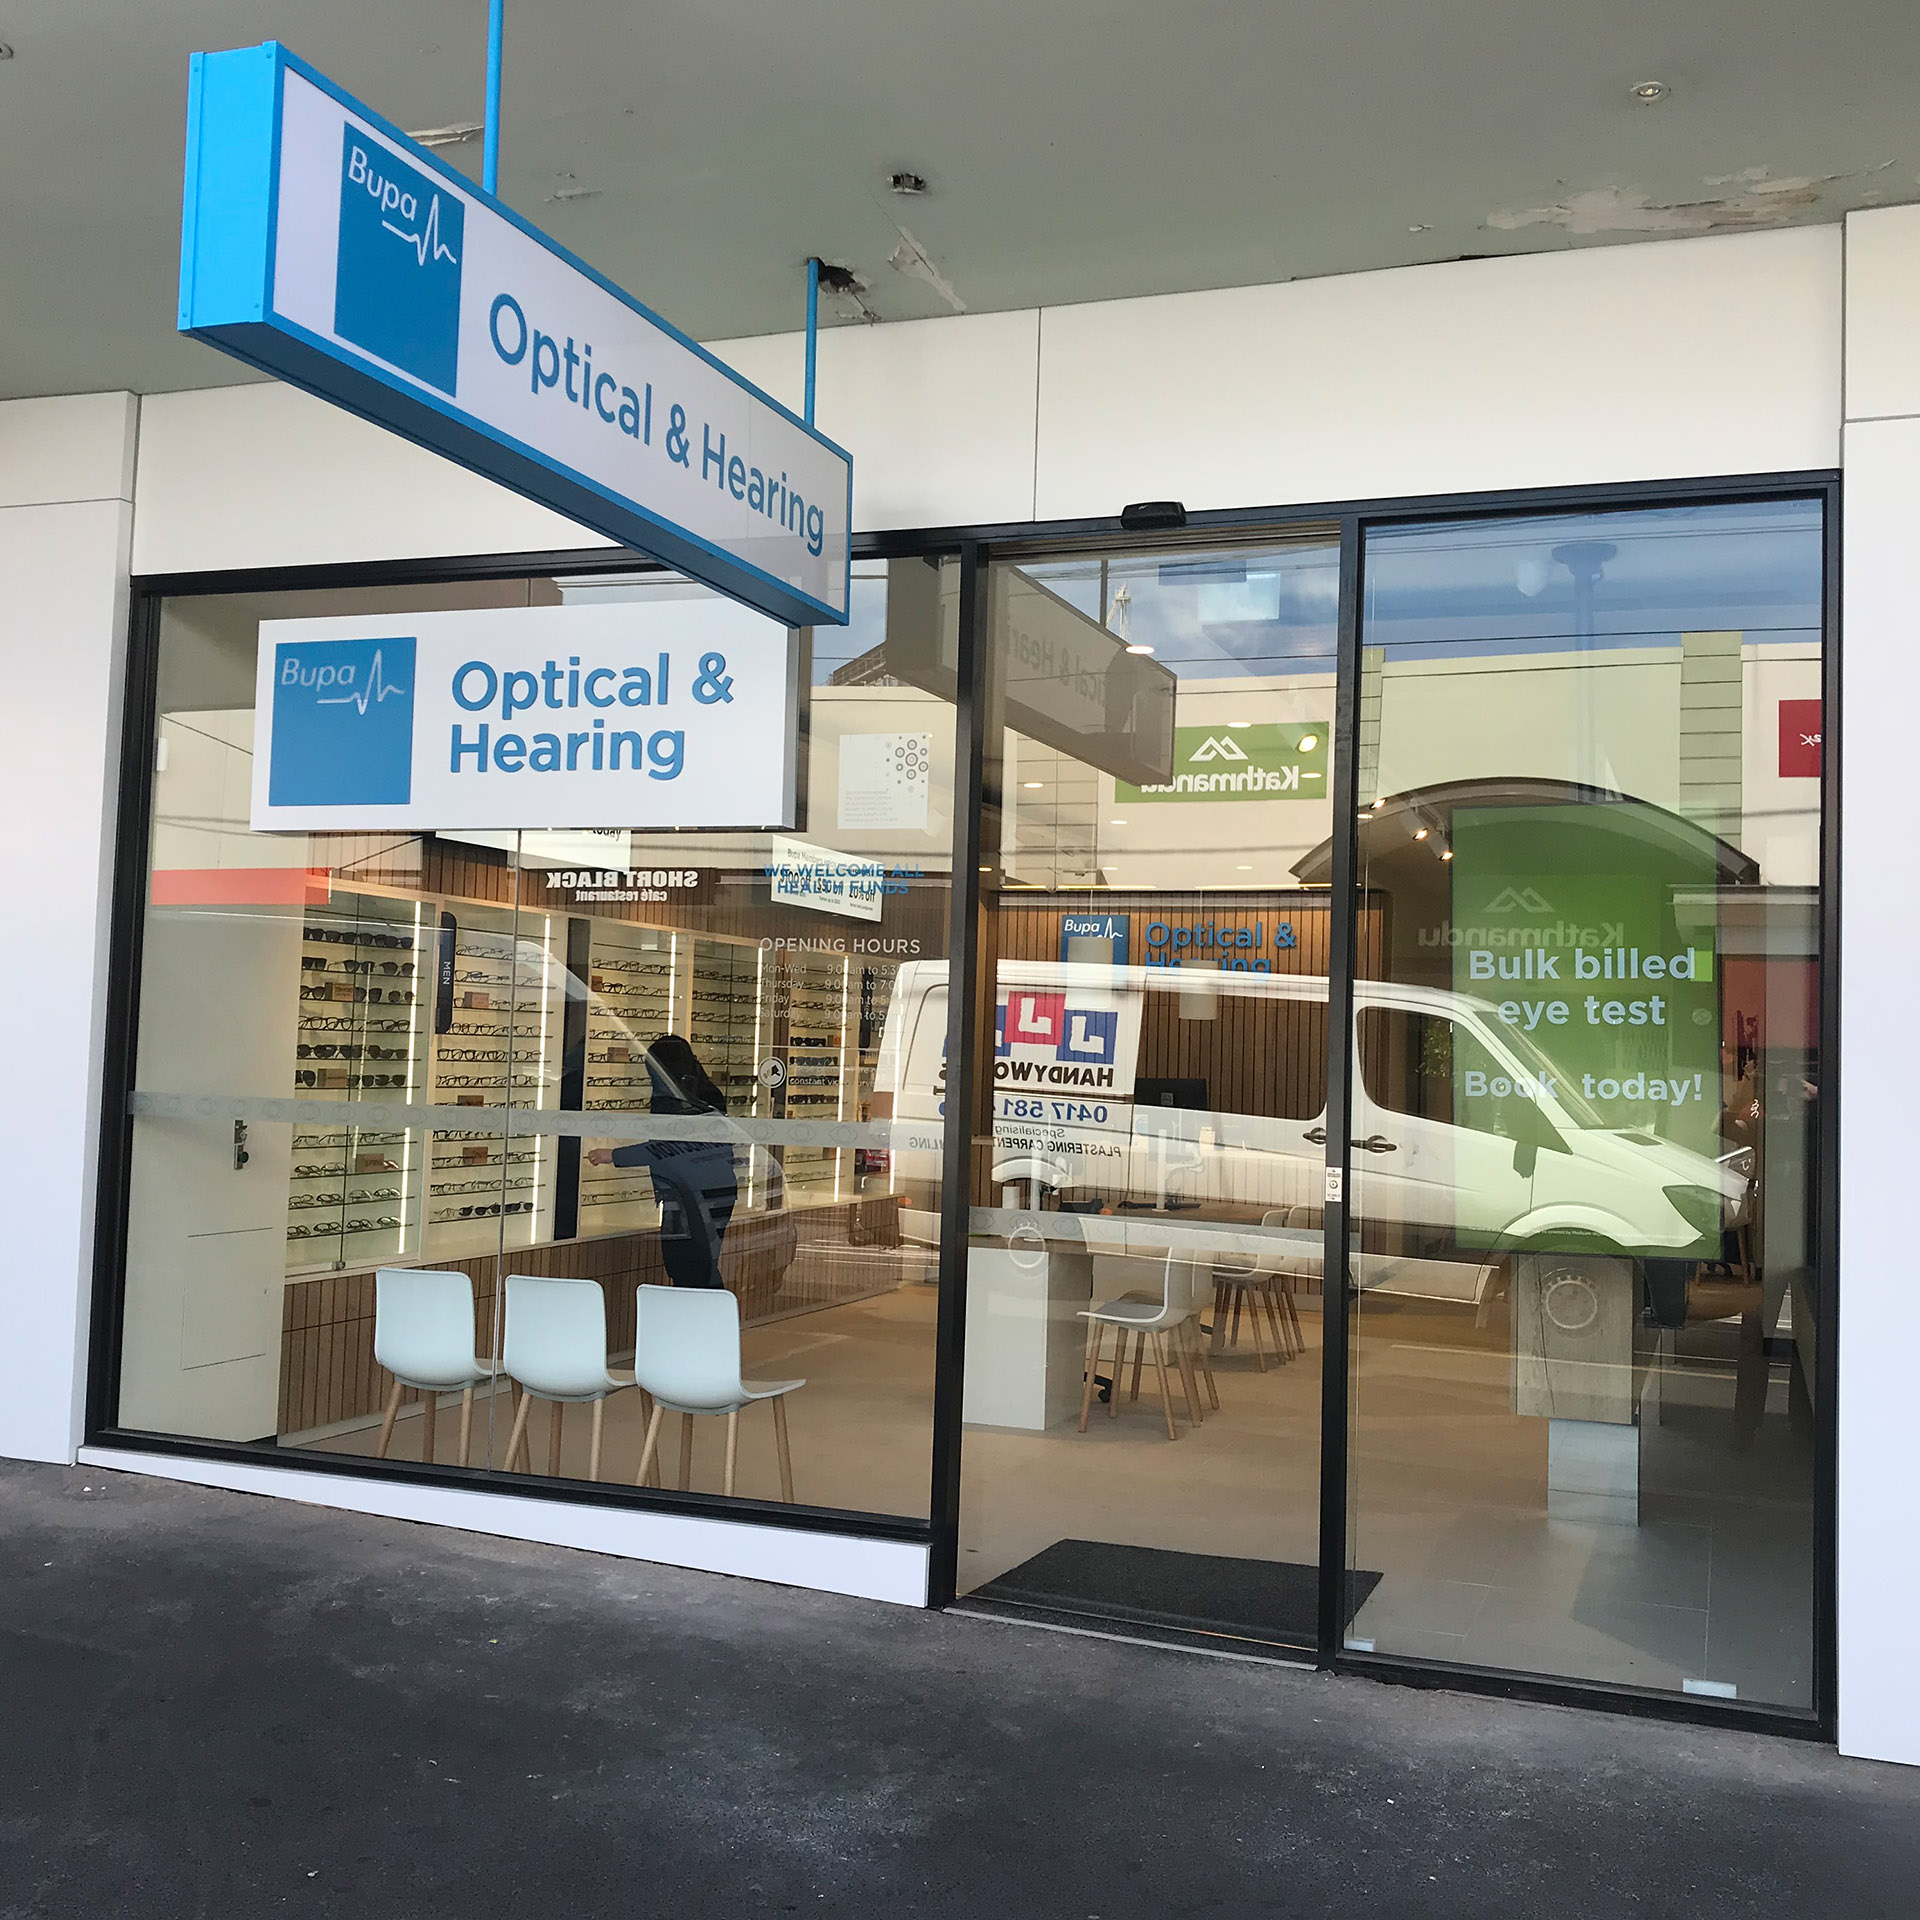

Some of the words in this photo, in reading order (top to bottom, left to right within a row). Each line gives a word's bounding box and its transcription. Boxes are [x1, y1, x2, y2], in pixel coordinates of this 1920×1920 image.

[348, 146, 418, 220] Bupa
[490, 293, 652, 448] Optical
[665, 403, 690, 468] &
[702, 424, 824, 556] Hearing
[281, 657, 356, 692] Bupa
[452, 652, 670, 720] Optical
[692, 651, 735, 704] &
[450, 719, 685, 781] Hearing
[764, 864, 791, 878] WE
[798, 864, 887, 879] WELCOME
[891, 863, 925, 878] ALL
[777, 880, 844, 894] HEALTH
[850, 880, 909, 895] FUNDS
[1064, 919, 1101, 935] Bupa
[1145, 921, 1262, 952] Optical
[1275, 922, 1297, 948] &
[759, 937, 847, 953] OPENING
[853, 939, 921, 954] HOURS
[443, 961, 452, 985] MEN
[1469, 948, 1561, 980] Bulk
[1574, 947, 1696, 980] billed
[1497, 1000, 1570, 1031] eye
[1584, 995, 1666, 1025] test
[1464, 1071, 1559, 1099] Book
[1581, 1072, 1702, 1107] today!
